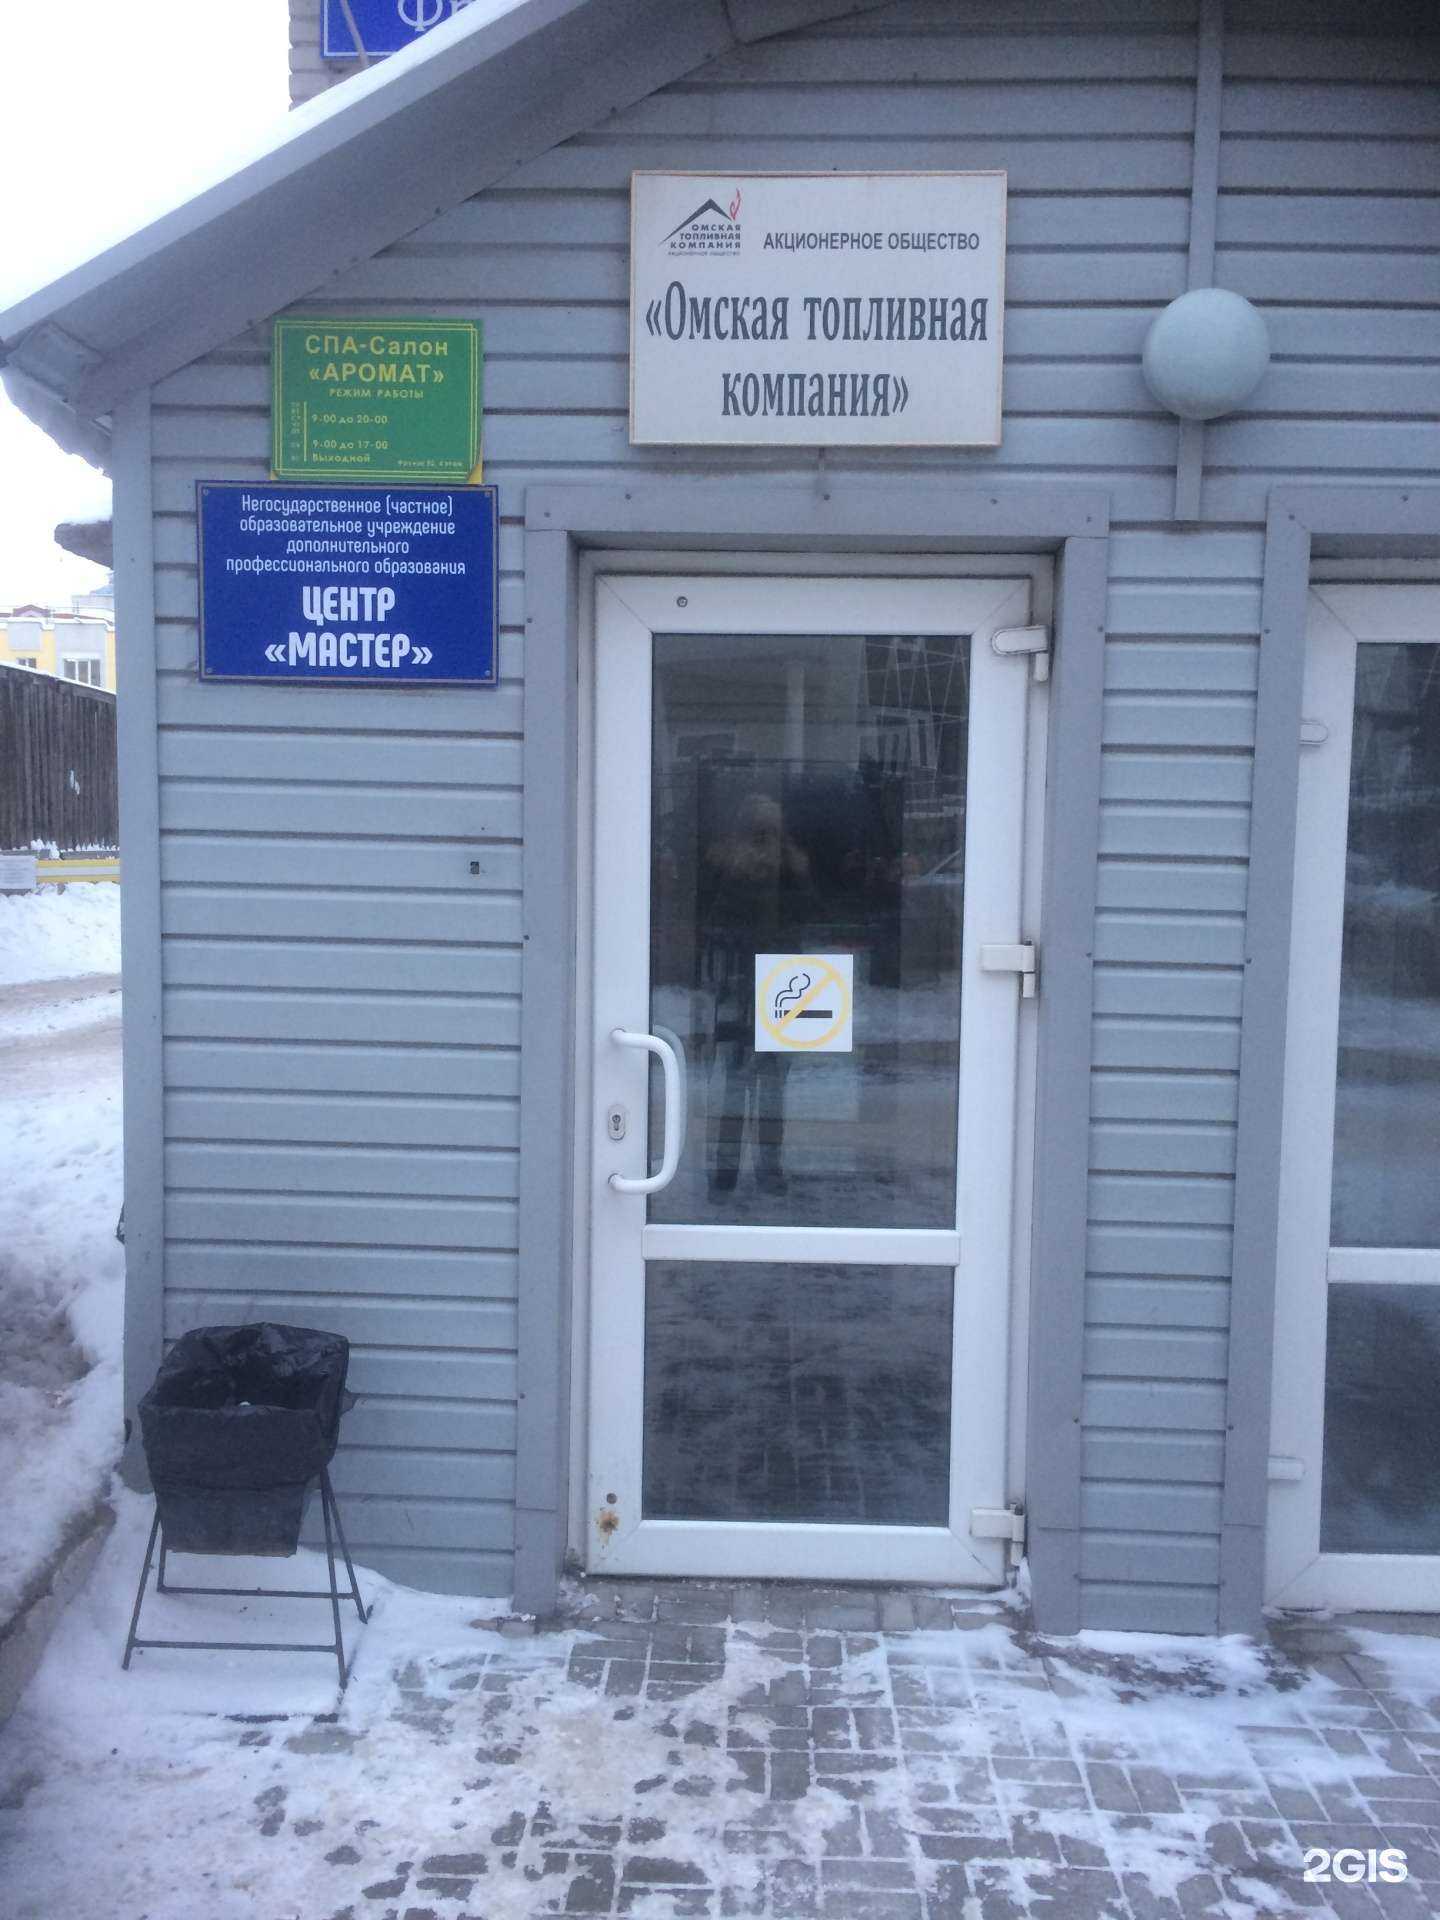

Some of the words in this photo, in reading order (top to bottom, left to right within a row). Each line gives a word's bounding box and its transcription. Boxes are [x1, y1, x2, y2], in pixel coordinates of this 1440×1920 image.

[670, 241, 741, 249] КОМПАНИЯ
[680, 232, 741, 240] ТОПЛИВНАЯ
[763, 232, 882, 252] АКЦИОНЕРНОЕ
[887, 233, 980, 253] ОБЩЕСТВО
[645, 280, 789, 341] «Омская
[803, 297, 989, 341] топливная
[305, 334, 448, 356] СПА-Салон
[308, 363, 444, 383] «АРОМАТ»
[329, 388, 371, 398] РЕЖИМ
[377, 389, 424, 399] РАБОТЫ
[722, 373, 909, 417] компания»
[339, 416, 353, 424] до
[340, 441, 354, 449] до
[312, 453, 370, 462] Выходной
[242, 495, 381, 515] Негосударственное
[386, 495, 453, 516] (частное)
[240, 516, 362, 535] образовательное
[367, 520, 455, 537] учреждение
[286, 539, 409, 554] дополнительного
[226, 556, 369, 575] профессионального
[374, 558, 466, 577] образования
[302, 586, 395, 626] ЦЕНТР
[264, 632, 433, 668] «МАСТЕР»
